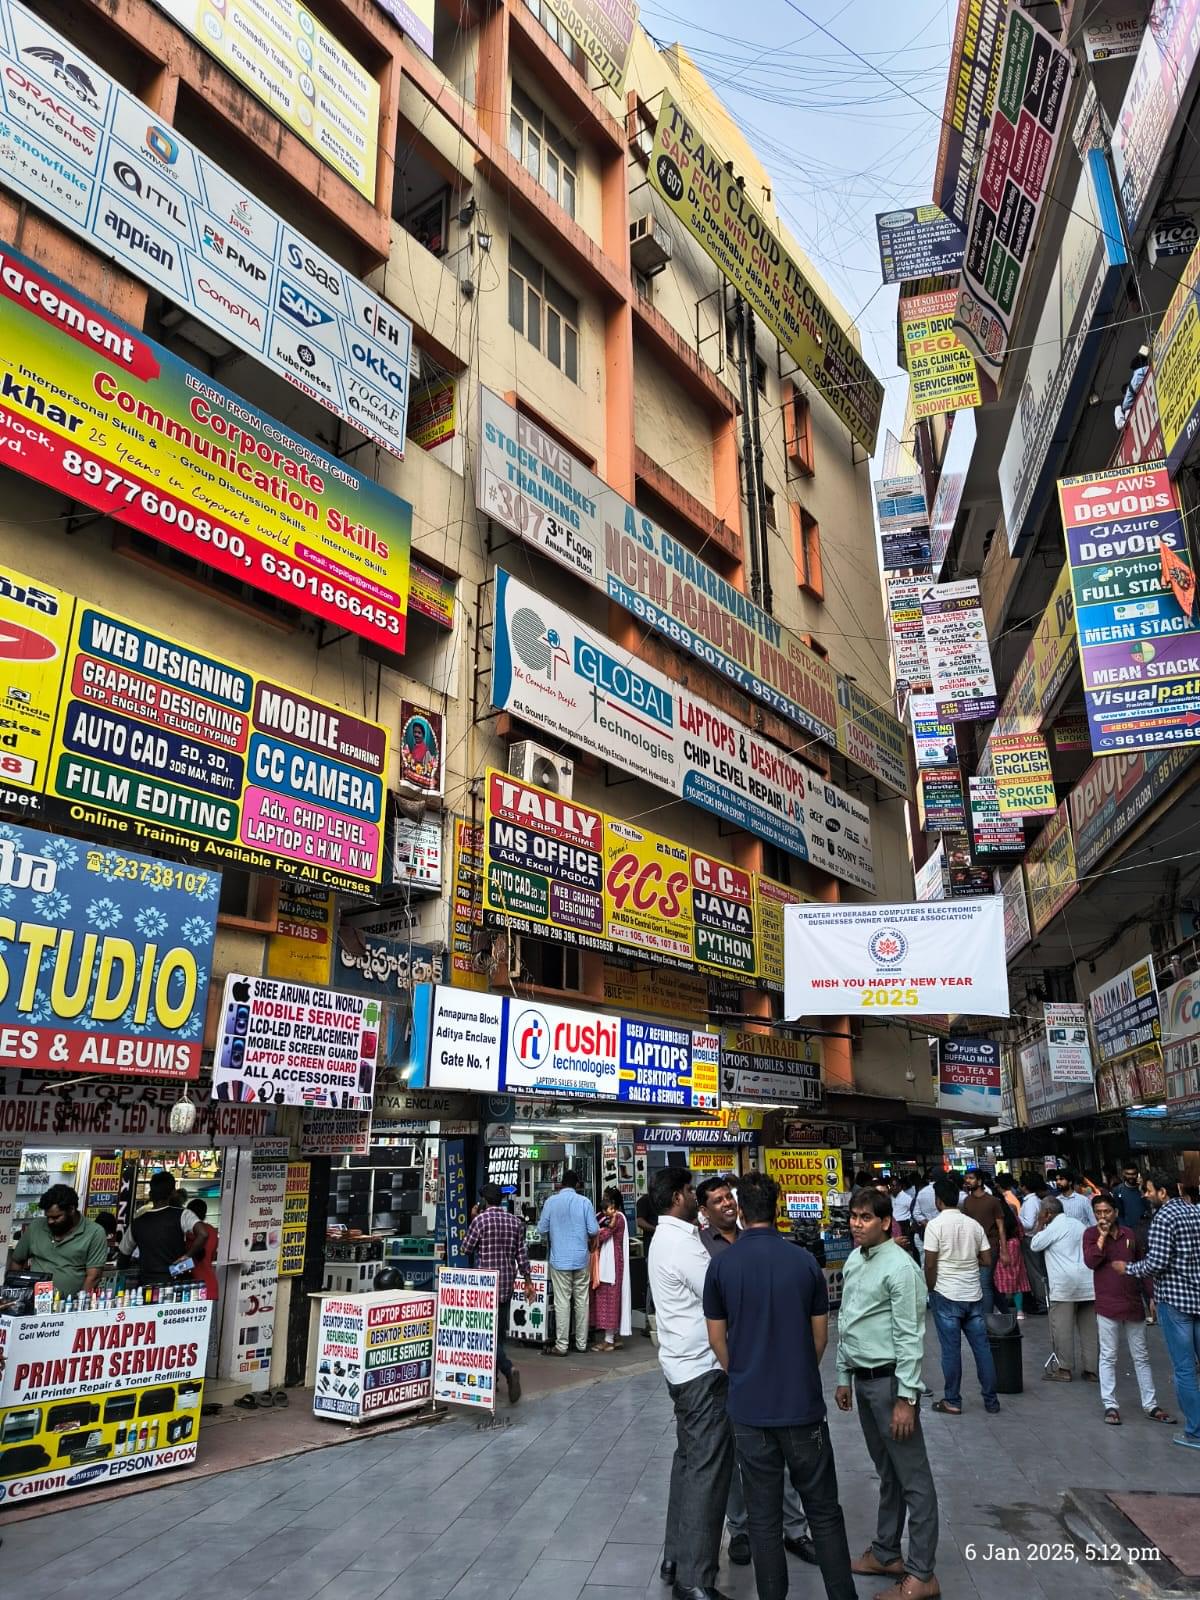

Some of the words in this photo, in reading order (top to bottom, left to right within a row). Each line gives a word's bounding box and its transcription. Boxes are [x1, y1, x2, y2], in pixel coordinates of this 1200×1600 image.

[231, 44, 256, 73] Forex
[259, 71, 290, 106] Trading
[6, 68, 96, 142] ORACLE
[8, 89, 94, 156] servicenow
[14, 134, 87, 191] snowflake
[661, 127, 689, 170] SAP
[692, 167, 720, 213] FICO
[669, 103, 721, 190] TEAM
[727, 185, 781, 265] CLOUD
[146, 181, 187, 227] ITIL
[104, 209, 174, 271] appian
[226, 246, 267, 283] PMP
[281, 281, 323, 326] SAP
[906, 321, 928, 331] AWS
[276, 346, 332, 394] kubernetes
[351, 342, 403, 393] okta
[931, 350, 971, 366] CLINICAL
[914, 372, 974, 392] SERVICENOW
[18, 364, 108, 420] Interpersonal
[112, 416, 145, 443] Skills
[348, 378, 399, 421] TOGAF
[916, 393, 978, 415] SNOWFLAKE
[186, 374, 224, 406] LEARN
[227, 401, 261, 430] FROM
[264, 423, 329, 472] CORPORATE
[331, 465, 360, 490] GURU
[189, 396, 324, 494] Corporate
[92, 370, 319, 522] Communication
[326, 508, 390, 560] Skills
[485, 422, 539, 475] STOCK
[541, 464, 597, 519] MARKET
[180, 456, 215, 481] Group
[218, 477, 277, 517] Discussion
[280, 512, 306, 532] Skills
[506, 461, 580, 530] TRAINING
[1116, 476, 1156, 494] AWS
[1074, 493, 1170, 521] DevOps
[63, 449, 252, 567] 8977600800,
[261, 552, 400, 635] 6301866453
[1111, 519, 1159, 535] Azure
[321, 534, 362, 563] Interview
[364, 558, 388, 577] Skills
[1080, 533, 1177, 560] DevOps
[604, 521, 667, 610] NCFM
[672, 572, 757, 671] ACADEMY
[1082, 583, 1123, 601] FULL
[1084, 624, 1135, 643] MERN
[1140, 615, 1196, 634] STACK
[91, 619, 140, 664] WEB
[143, 640, 245, 705] DESIGNING
[1092, 666, 1142, 684] MEAN
[1147, 658, 1199, 675] STACK
[579, 645, 672, 725] GLOBAL
[258, 689, 340, 750] MOBILE
[72, 712, 126, 756] AUTO
[130, 730, 169, 770] CAD
[678, 696, 736, 757] LAPTOPS
[750, 740, 805, 800] DESKTOPS
[683, 739, 710, 769] CHIP
[713, 756, 747, 792] LEVEL
[994, 750, 1047, 765] SPOKEN
[996, 762, 1048, 775] ENGLISH
[254, 743, 285, 783] CC
[290, 755, 375, 814] CAMERA
[999, 785, 1053, 798] SPOKEN
[65, 762, 131, 806] FILM
[135, 782, 232, 832] EDITING
[496, 779, 597, 838] TALLY
[1007, 796, 1048, 808] HINDI
[70, 805, 128, 832] Online
[134, 822, 200, 853] Training
[204, 840, 271, 868] Available
[275, 860, 298, 875] For
[301, 866, 319, 881] All
[322, 872, 371, 893] Courses
[494, 821, 528, 851] MS
[533, 834, 599, 877] OFFICE
[606, 854, 689, 918] GCS
[559, 900, 595, 920] DESIGNING
[695, 896, 750, 926] JAVA
[832, 910, 877, 918] HYDERABAD
[879, 908, 926, 916] COMPUTERS
[928, 906, 982, 914] ELECTRONICS
[699, 931, 751, 960] PYTHON
[254, 980, 279, 1000] SREE
[280, 985, 310, 1005] ARUNA
[313, 990, 332, 1009] CELL
[335, 994, 363, 1014] WORLD
[812, 979, 839, 988] WISH
[842, 979, 865, 987] YOU
[868, 978, 907, 987] HAPPY
[910, 978, 936, 986] NEW
[940, 977, 973, 986] YEAR
[861, 989, 919, 1006] 2025
[252, 1000, 304, 1022] MOBILE
[307, 1009, 361, 1031] SERVICE
[437, 1006, 478, 1024] Annapurna
[479, 1011, 499, 1025] Block
[249, 1018, 291, 1038] LCD-LED
[293, 1024, 359, 1047] REPLACEMENT
[436, 1026, 463, 1042] Aditya
[465, 1030, 496, 1045] Enclave
[554, 1021, 617, 1059] rushi
[79, 1036, 191, 1071] ALBUMS
[246, 1050, 284, 1065] LAPTOP
[287, 1054, 325, 1070] SCREEN
[327, 1059, 357, 1073] GUARD
[440, 1051, 464, 1068] Gate
[466, 1054, 482, 1069] No.
[485, 1056, 490, 1069] 1
[553, 1054, 616, 1078] technologies
[626, 1043, 688, 1071] LAPTOPS
[976, 1055, 994, 1064] MILK
[243, 1065, 268, 1079] ALL
[272, 1069, 356, 1087] ACCESSORIES
[952, 1076, 988, 1084] COFFEE
[769, 1157, 822, 1170] MOBILES
[788, 1195, 820, 1203] PRINTER
[789, 1211, 822, 1219] REFILLING
[370, 1309, 400, 1323] LAPTOP
[401, 1303, 432, 1318] SERVICE
[440, 1289, 463, 1307] MOBILE
[464, 1291, 494, 1309] SERVICE
[72, 1321, 156, 1353] AYYAPPA
[14, 1354, 104, 1391] PRINTER
[108, 1343, 198, 1377] SERVICES
[437, 1350, 448, 1363] ALL
[449, 1352, 493, 1370] ACCESSORIES
[23, 1392, 38, 1401] All
[41, 1386, 77, 1399] Printer
[80, 1381, 111, 1393] Repair
[125, 1376, 152, 1386] Toner
[365, 1382, 429, 1408] REPLACEMENT
[8, 1474, 66, 1497] Canon
[109, 1455, 153, 1476] EPSON
[154, 1447, 196, 1466] xerox
